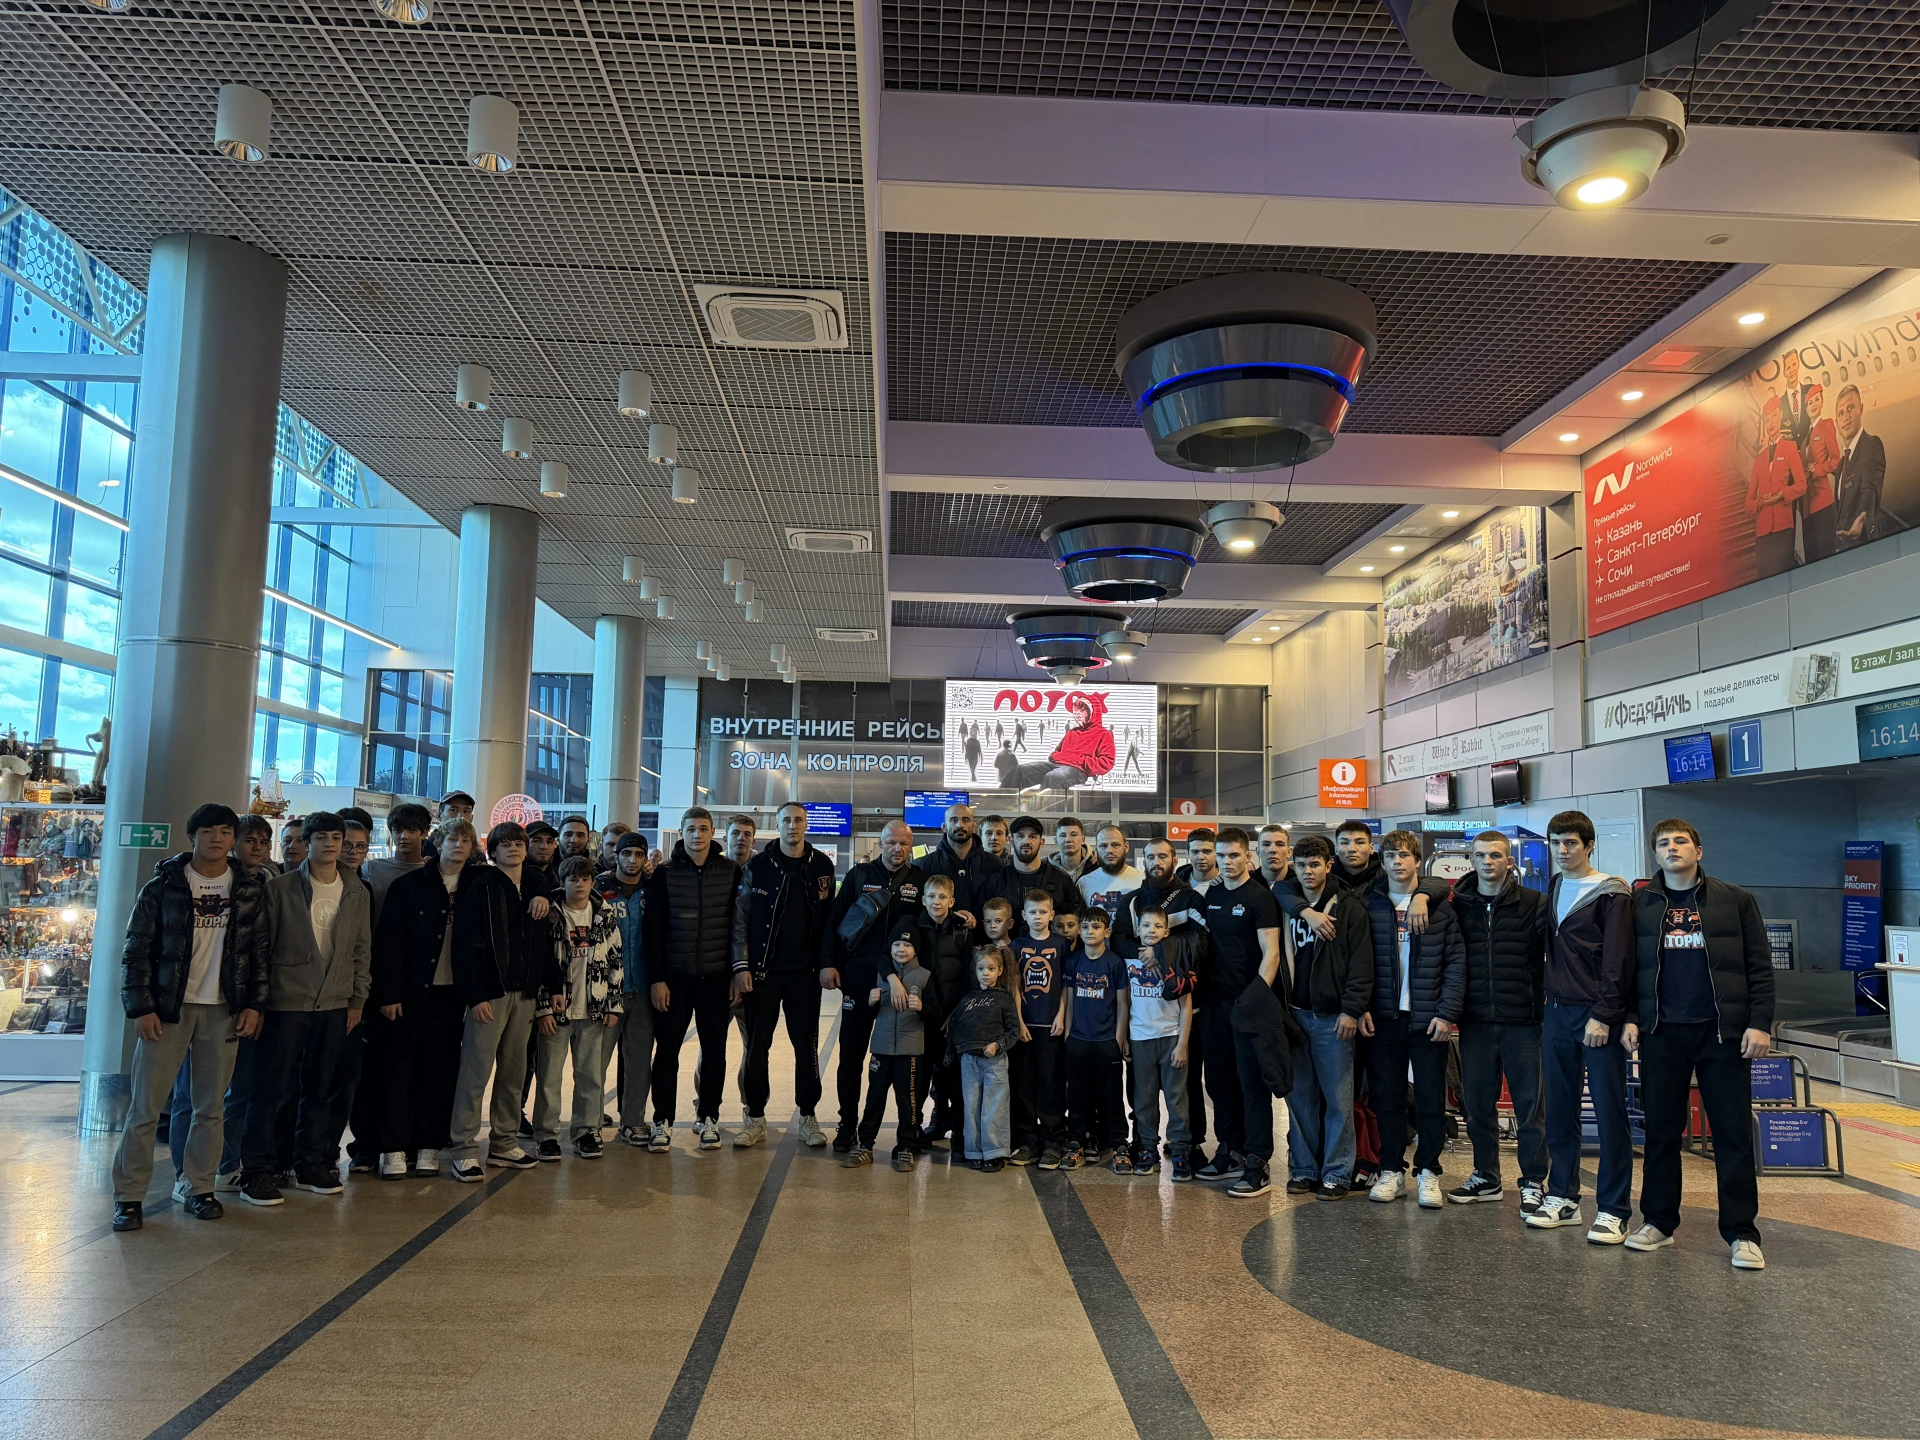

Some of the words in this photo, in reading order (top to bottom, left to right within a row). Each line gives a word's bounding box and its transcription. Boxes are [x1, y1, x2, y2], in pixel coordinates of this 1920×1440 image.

[1743, 316, 1920, 387] odwind
[1636, 446, 1672, 474] Nordwind
[1636, 470, 1650, 481] Airlines
[1594, 511, 1616, 528] Прямые
[1616, 502, 1636, 518] рейсы:
[1606, 520, 1642, 544] Казань
[1607, 513, 1702, 564] Санкт-Петербург
[1596, 596, 1603, 605] Не
[1604, 579, 1645, 602] откладывайте
[1646, 560, 1690, 586] путешествие!
[1608, 564, 1633, 583] Сочи
[1854, 658, 1860, 670] 2
[1862, 655, 1886, 668] этаж
[1896, 649, 1914, 661] зал
[1704, 682, 1731, 696] мясные
[1733, 672, 1780, 691] деликатесы
[1704, 695, 1735, 709] подарки
[710, 718, 855, 738] ВНУТРЕННИЕ
[868, 718, 945, 739] РЕЙСЫ
[1870, 722, 1920, 748] 16:14
[1432, 745, 1450, 760] White
[1461, 738, 1483, 754] Rabbit
[1742, 732, 1750, 762] 1
[729, 751, 791, 770] ЗОНА
[806, 754, 924, 772] КОНТРОЛЯ
[1675, 754, 1707, 773] 16:14
[1077, 988, 1104, 999] ШТОРМ
